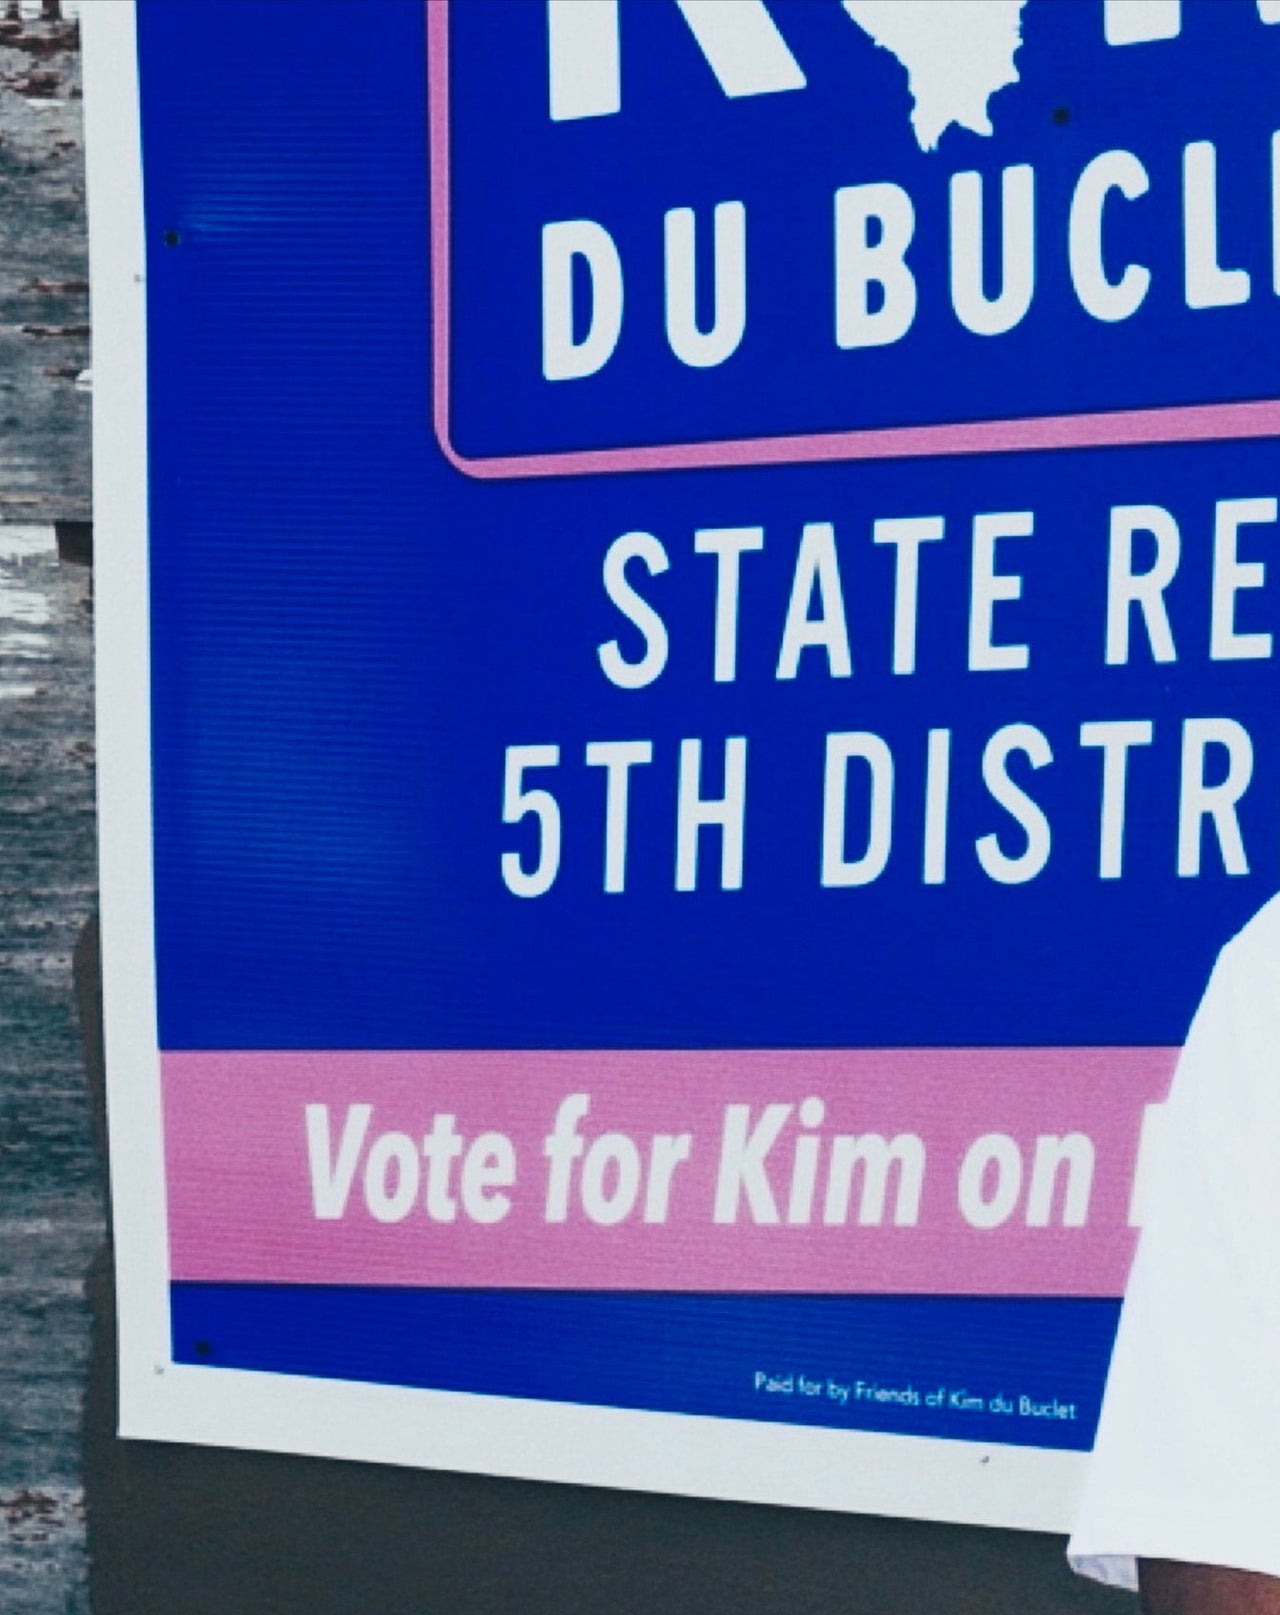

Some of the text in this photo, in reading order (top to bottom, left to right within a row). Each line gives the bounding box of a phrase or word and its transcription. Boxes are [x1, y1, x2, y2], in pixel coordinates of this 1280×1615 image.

[541, 200, 747, 382] DU
[596, 510, 1035, 690] STATE
[501, 735, 748, 898] 5TH
[303, 1103, 517, 1224] Vote
[542, 1093, 693, 1227] for
[712, 1096, 927, 1227] Kim
[956, 1131, 1096, 1230] on
[754, 1370, 1078, 1421] Paid for by Friends of Kim du Buclet
